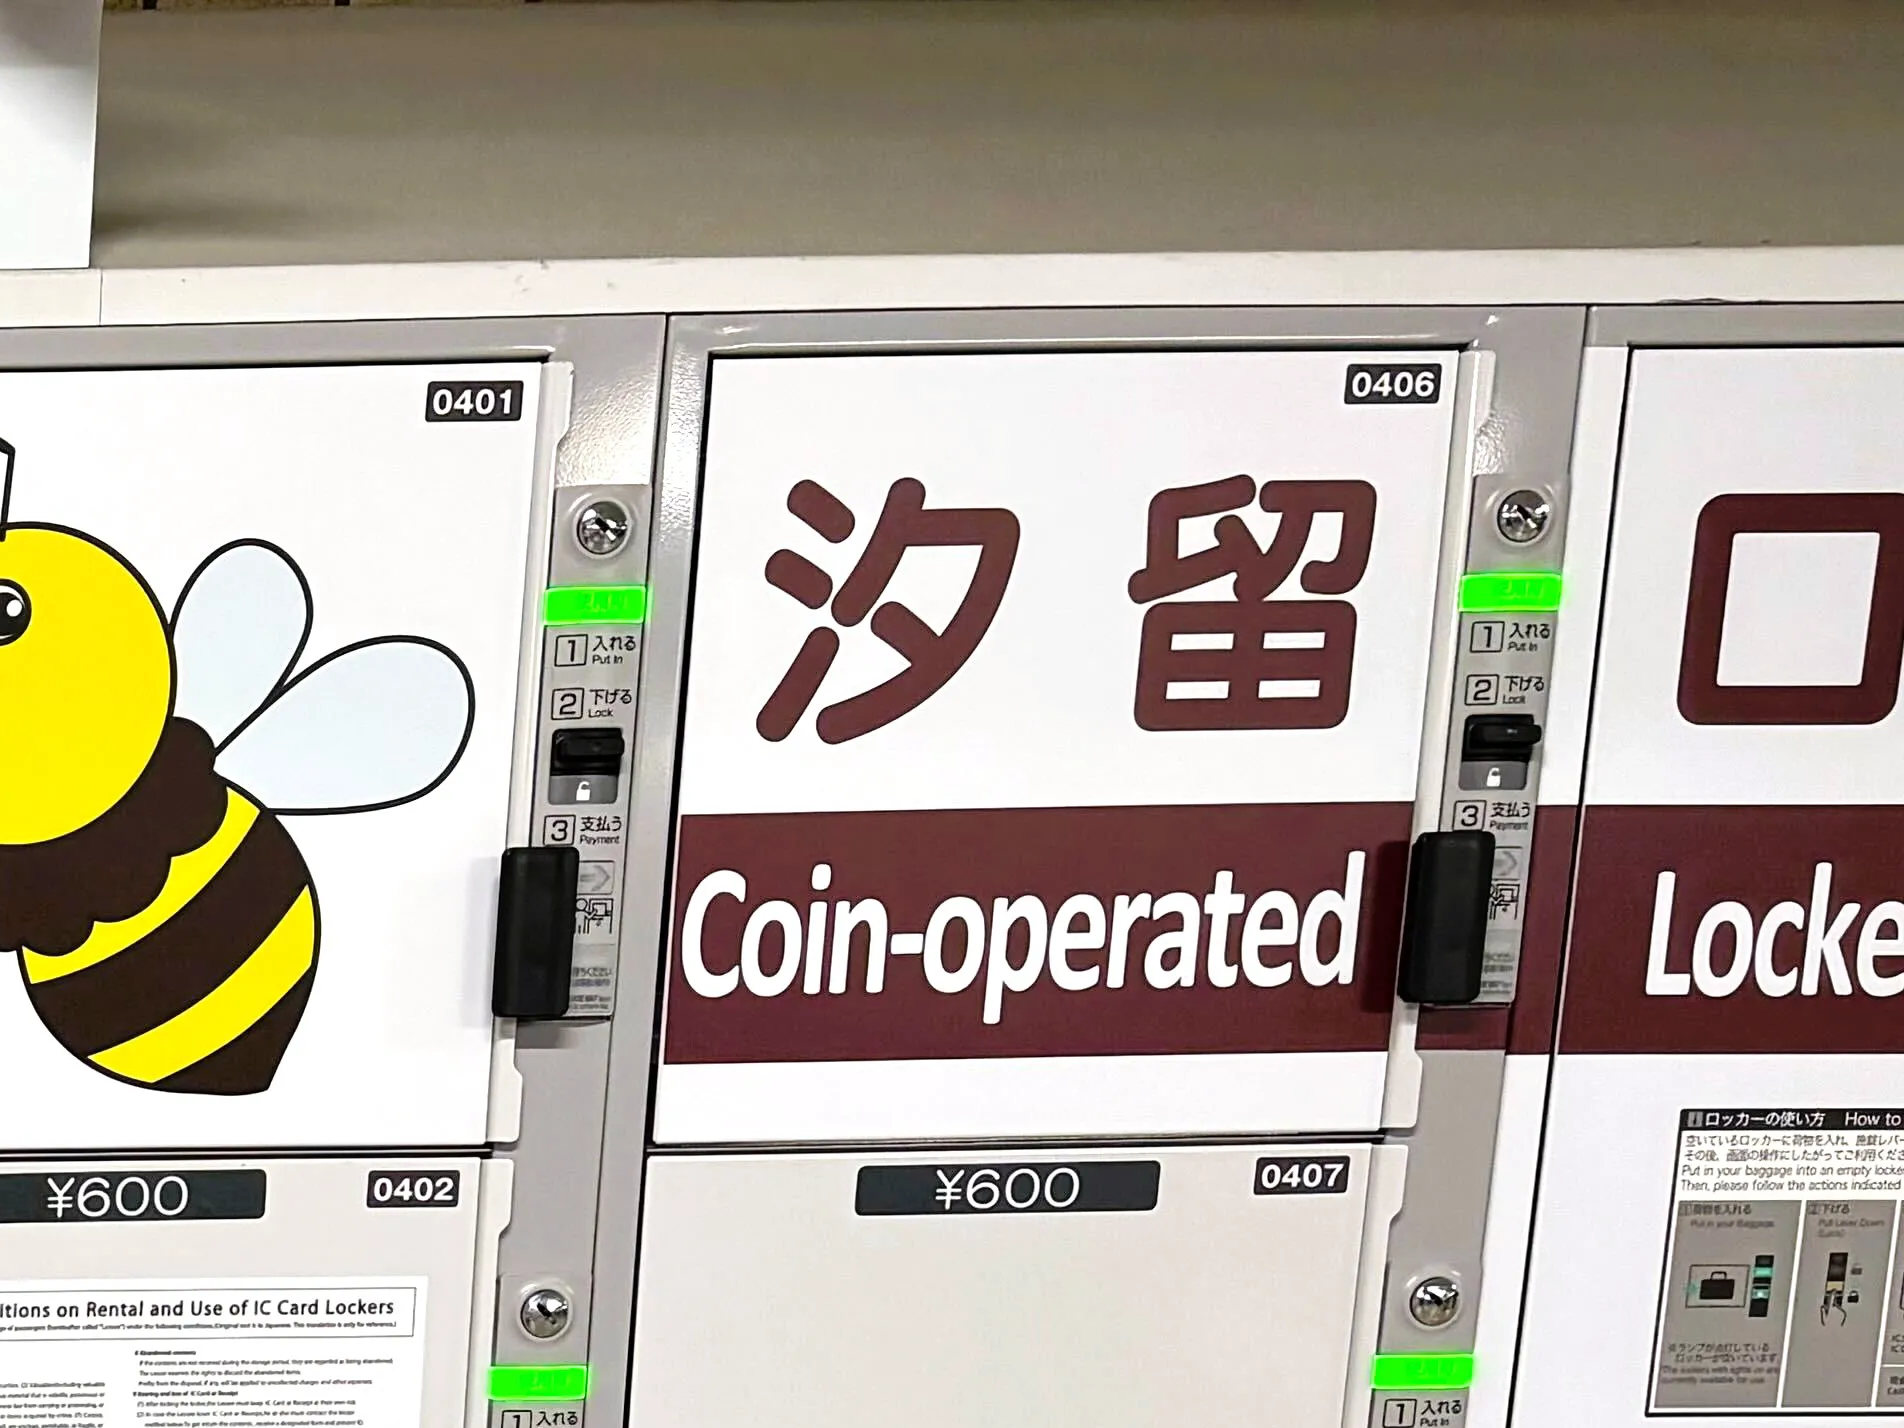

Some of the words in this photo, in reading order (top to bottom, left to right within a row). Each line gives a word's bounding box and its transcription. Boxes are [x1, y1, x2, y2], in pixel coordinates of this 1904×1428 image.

[1352, 371, 1435, 398] 0406
[432, 388, 512, 415] 0401
[567, 639, 576, 663] 1
[592, 635, 637, 652] 入れる
[591, 654, 611, 665] Put
[559, 692, 577, 716] 2
[589, 688, 633, 706] 下げる
[587, 707, 614, 719] Lock
[550, 819, 569, 842] 3
[579, 815, 622, 833] 支払う
[579, 834, 620, 846] Payment
[681, 850, 1366, 1025] Coin-operated
[1705, 1111, 1826, 1128] ロッカーの使い方
[1844, 1111, 1881, 1127] How
[1885, 1112, 1902, 1127] to
[373, 1177, 454, 1202] 0402
[1261, 1163, 1344, 1189] 0407
[47, 1176, 189, 1219] ¥600
[936, 1167, 1080, 1214] ¥600
[56, 1305, 79, 1318] on
[86, 1300, 144, 1318] Rental
[150, 1299, 184, 1317] and
[190, 1300, 223, 1317] Use
[229, 1299, 249, 1316] of
[254, 1299, 272, 1316] IC
[277, 1298, 319, 1316] Card
[325, 1298, 394, 1315] Lockers
